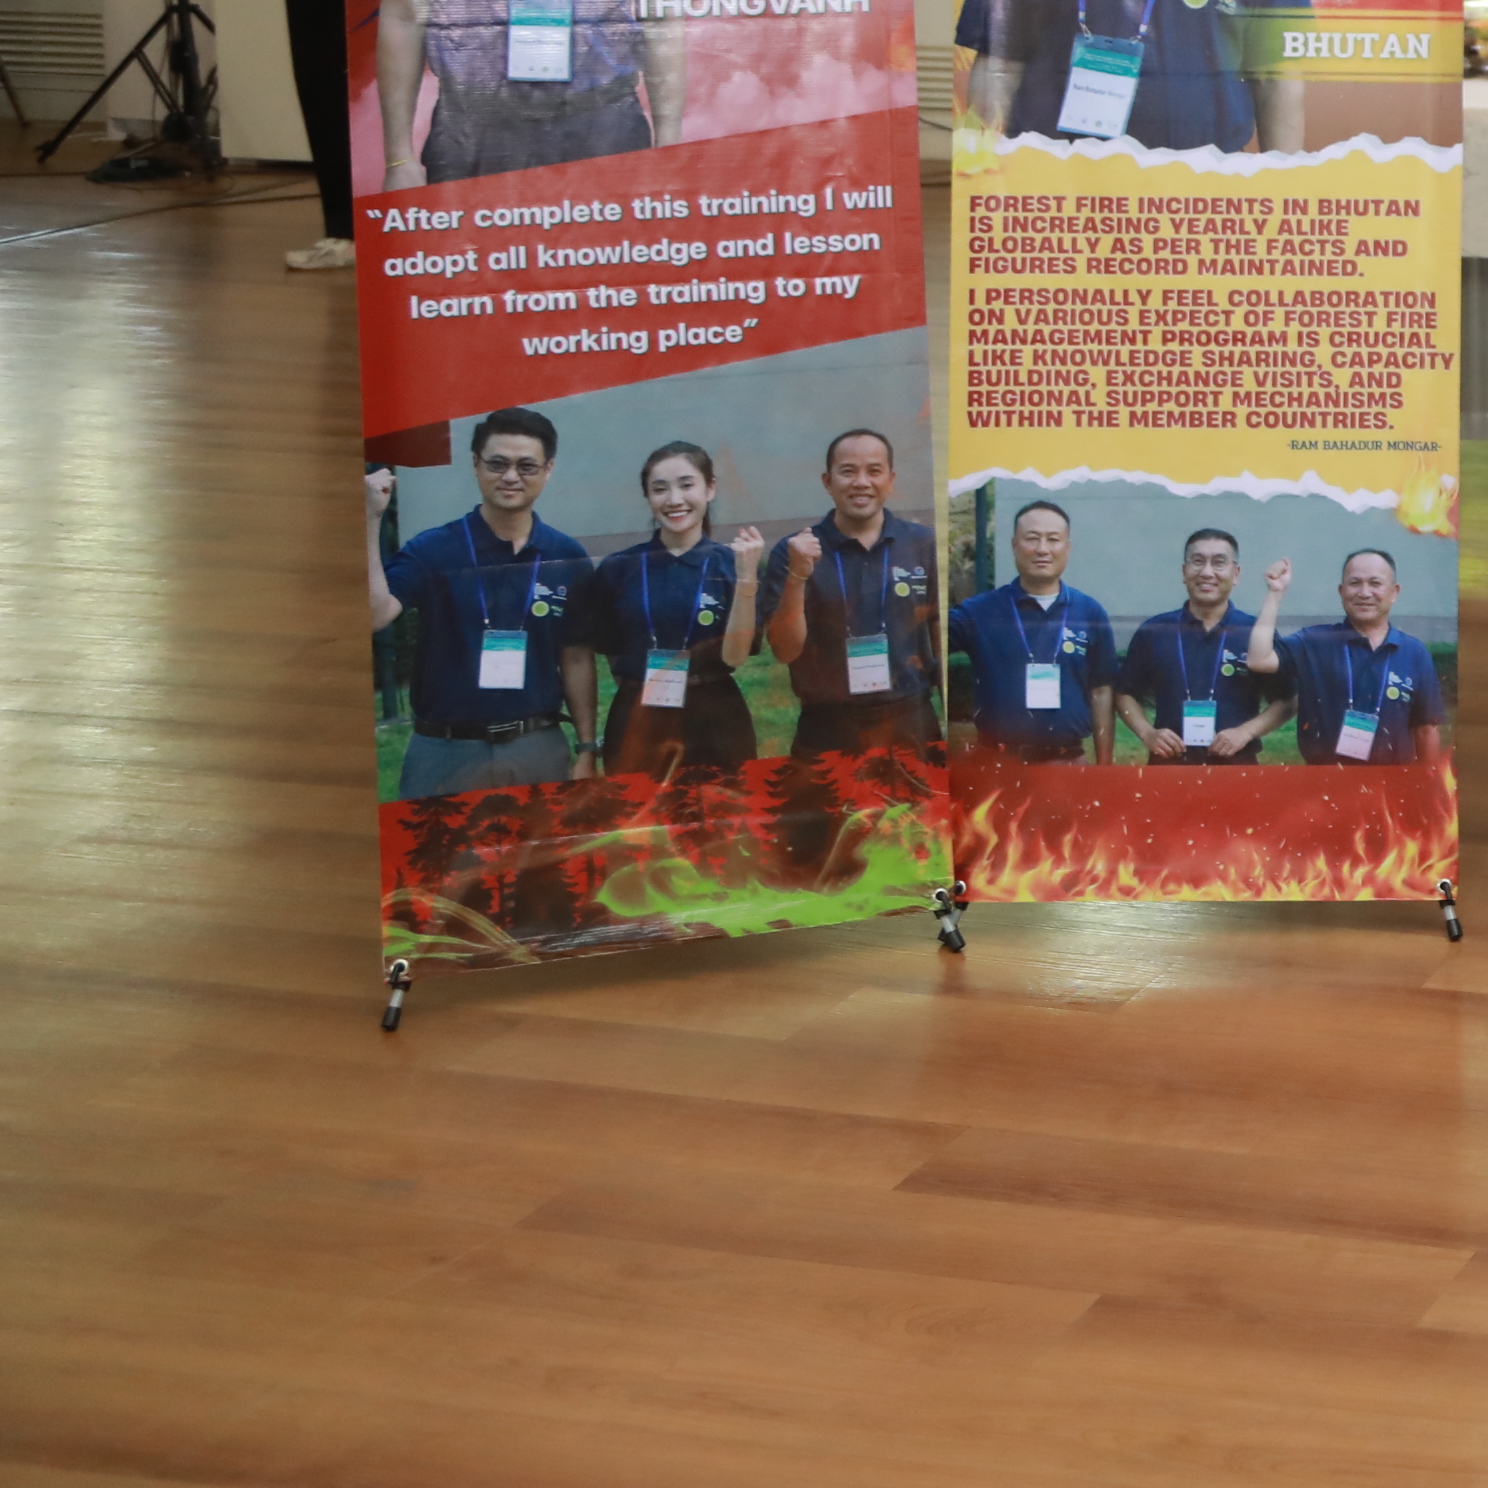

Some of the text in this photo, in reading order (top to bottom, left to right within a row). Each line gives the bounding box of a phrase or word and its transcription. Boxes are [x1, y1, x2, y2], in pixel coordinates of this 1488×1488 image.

[1283, 31, 1431, 60] BHUTAN
[473, 199, 623, 230] complete
[631, 194, 690, 220] this
[697, 188, 816, 217] training
[824, 184, 834, 211] I
[842, 184, 893, 210] will
[969, 194, 1420, 217] FOREST FIRE INCIDENTS IN BHUTAN
[969, 215, 1349, 237] IS INCREASING YEARLY ALIKE
[384, 231, 881, 279] adopt all knowledge and lesson
[968, 235, 1408, 258] GLOBALLY AS PER THE FACTS AND
[968, 256, 1365, 278] FIGURES RECORD MAINTAINED.
[410, 273, 862, 320] learn from the training to my
[968, 287, 1436, 310] I PERSONALLY FEEL COLLABORATION
[521, 326, 649, 356] working
[966, 409, 1395, 430] WITHIN THE MEMBER COUNTRIES.
[1322, 439, 1383, 451] BAHADUR
